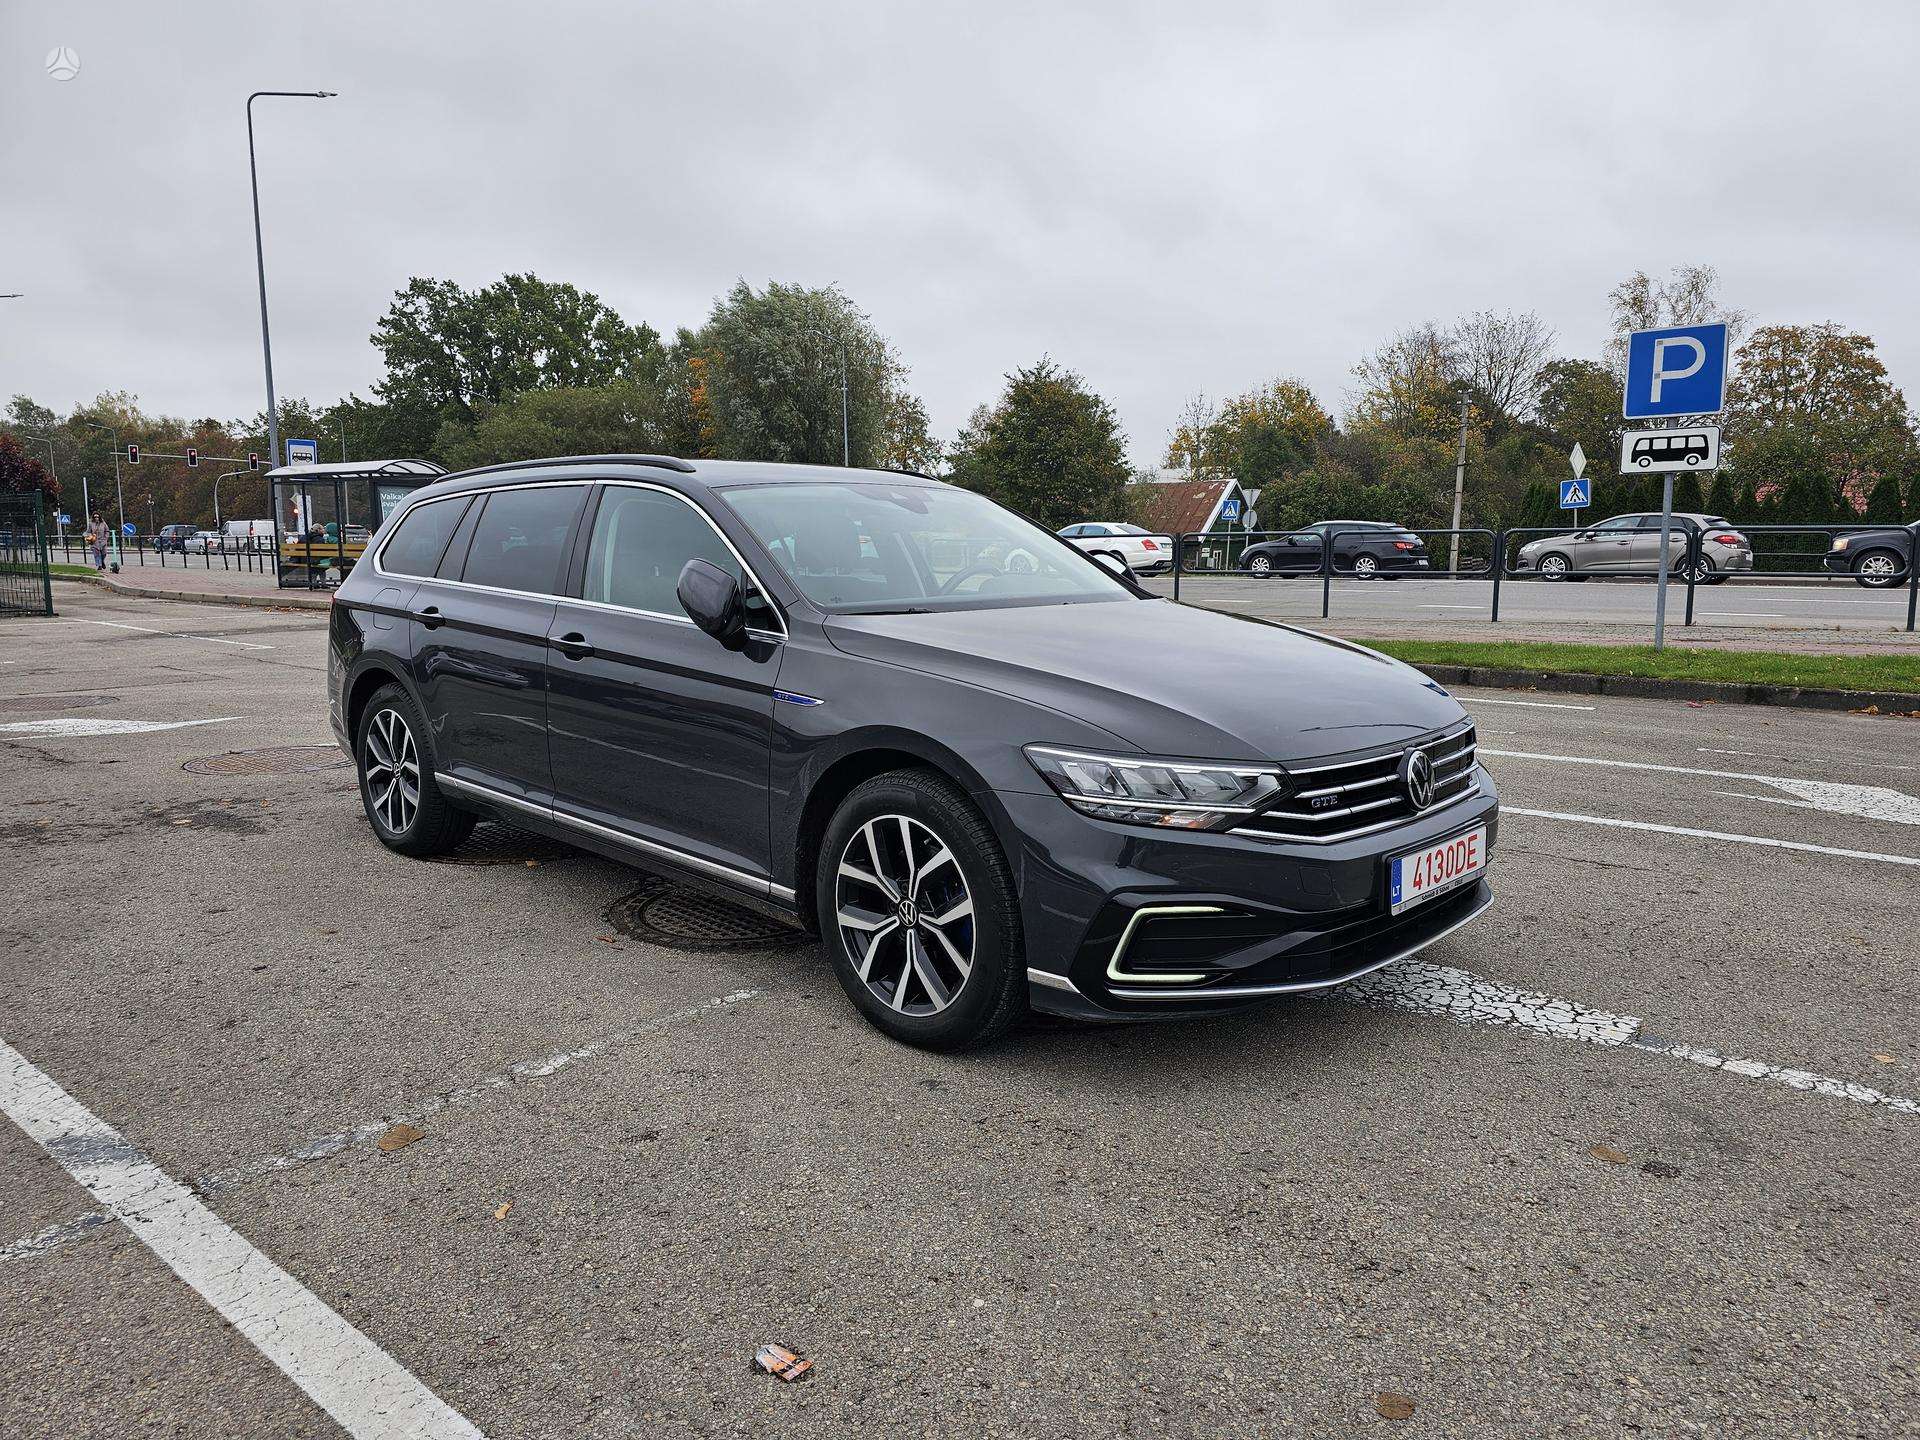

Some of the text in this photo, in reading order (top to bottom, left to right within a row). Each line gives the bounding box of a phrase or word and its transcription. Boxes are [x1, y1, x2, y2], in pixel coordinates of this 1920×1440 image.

[1651, 336, 1706, 403] P
[1311, 794, 1338, 808] GTE
[1413, 834, 1478, 890] 4130DE
[1392, 885, 1401, 897] LT
